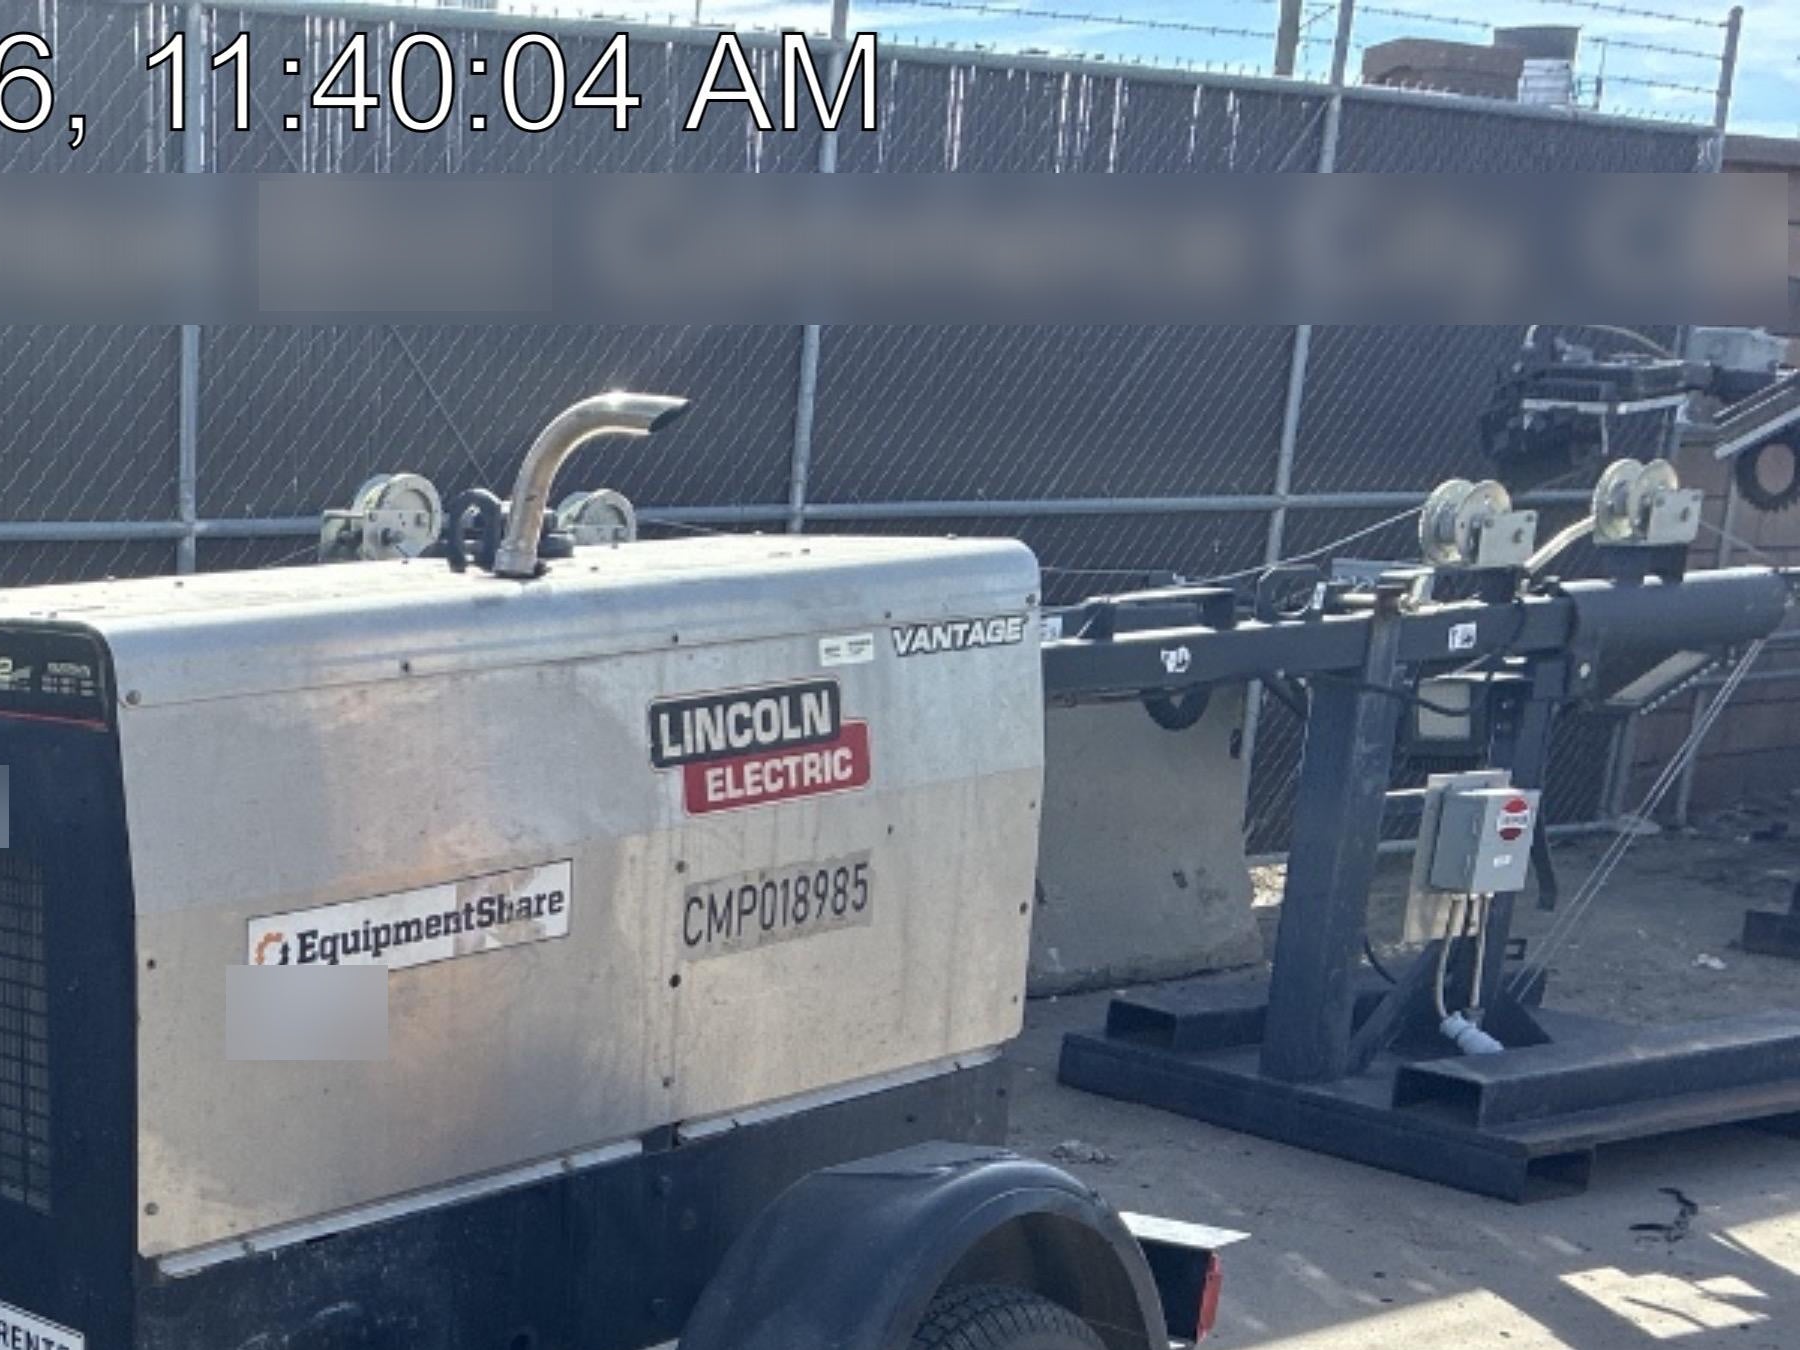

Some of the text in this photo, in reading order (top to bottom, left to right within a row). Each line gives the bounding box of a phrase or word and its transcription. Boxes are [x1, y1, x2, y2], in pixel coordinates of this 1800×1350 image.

[891, 615, 1028, 658] VANTAGE
[658, 688, 833, 760] LINCOLN
[705, 746, 854, 803] ELECTRIC
[295, 889, 565, 965] EquipmentShare
[682, 861, 869, 948] CMP018985
